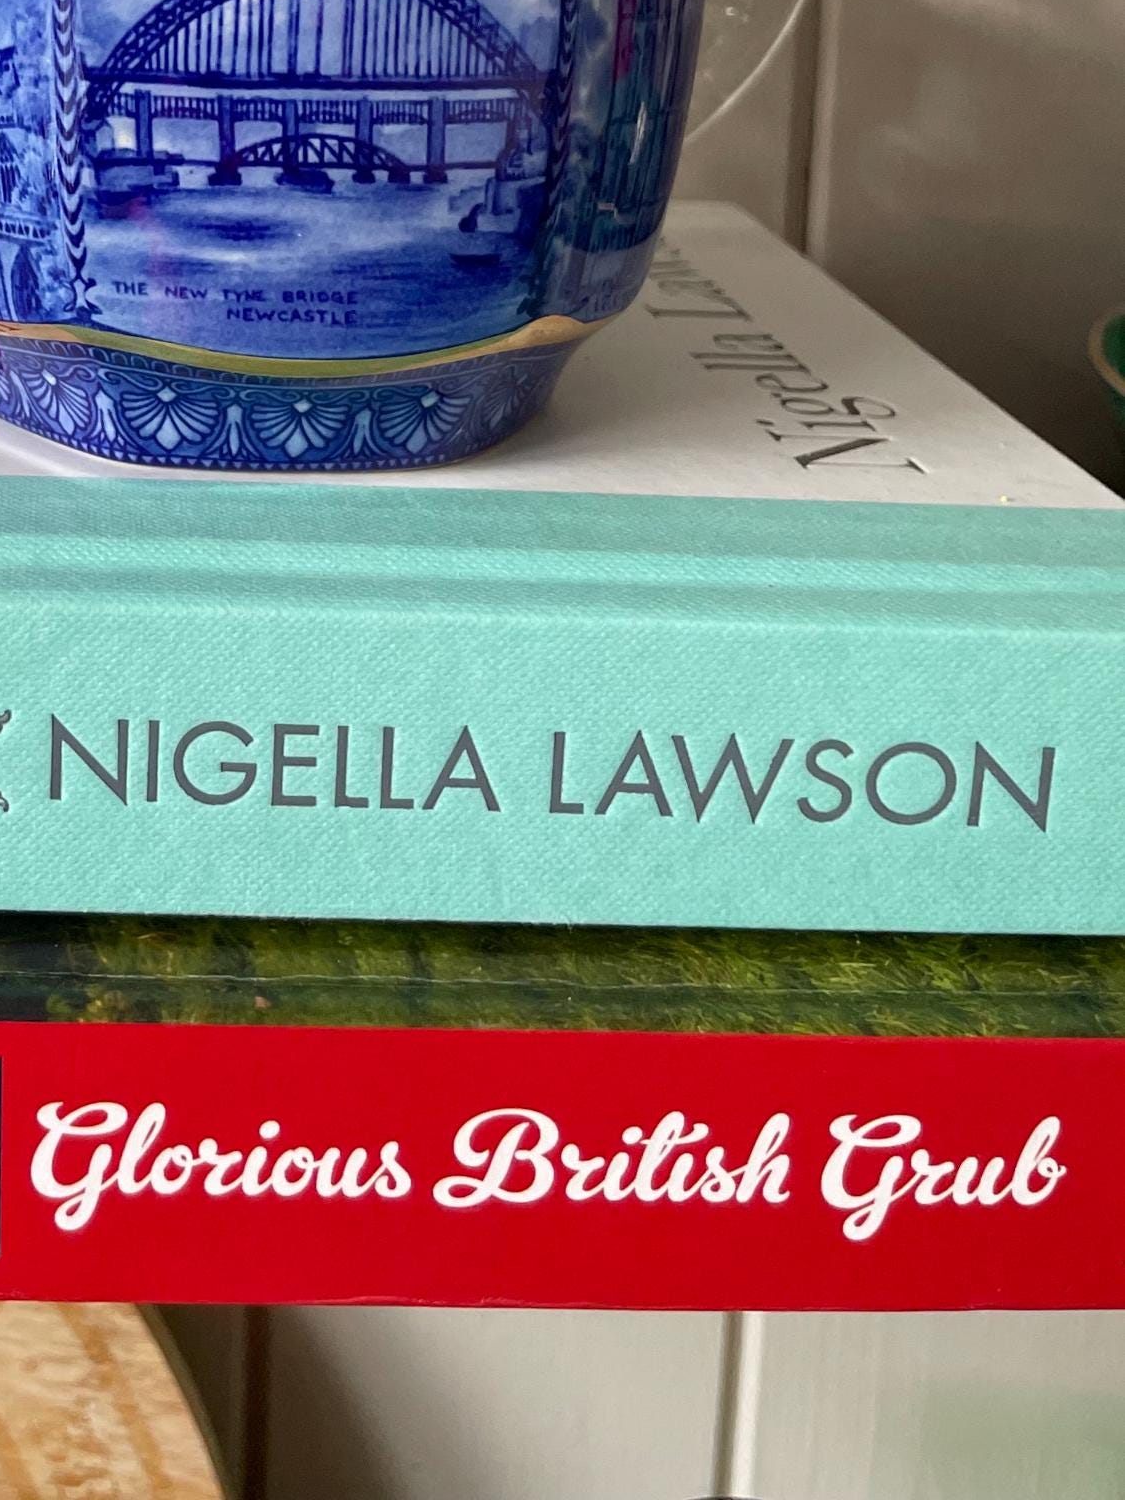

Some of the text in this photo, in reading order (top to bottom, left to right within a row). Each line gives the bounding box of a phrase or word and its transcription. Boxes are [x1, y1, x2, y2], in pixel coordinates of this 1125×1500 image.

[110, 280, 359, 305] THE NEW TYNE BRIDGE
[226, 307, 358, 326] NEWCASTLE
[690, 333, 929, 474] Nigella
[49, 713, 501, 812] NIGELLA
[548, 729, 1056, 833] LAWSON
[30, 1102, 1068, 1242] Glorious British Grub
